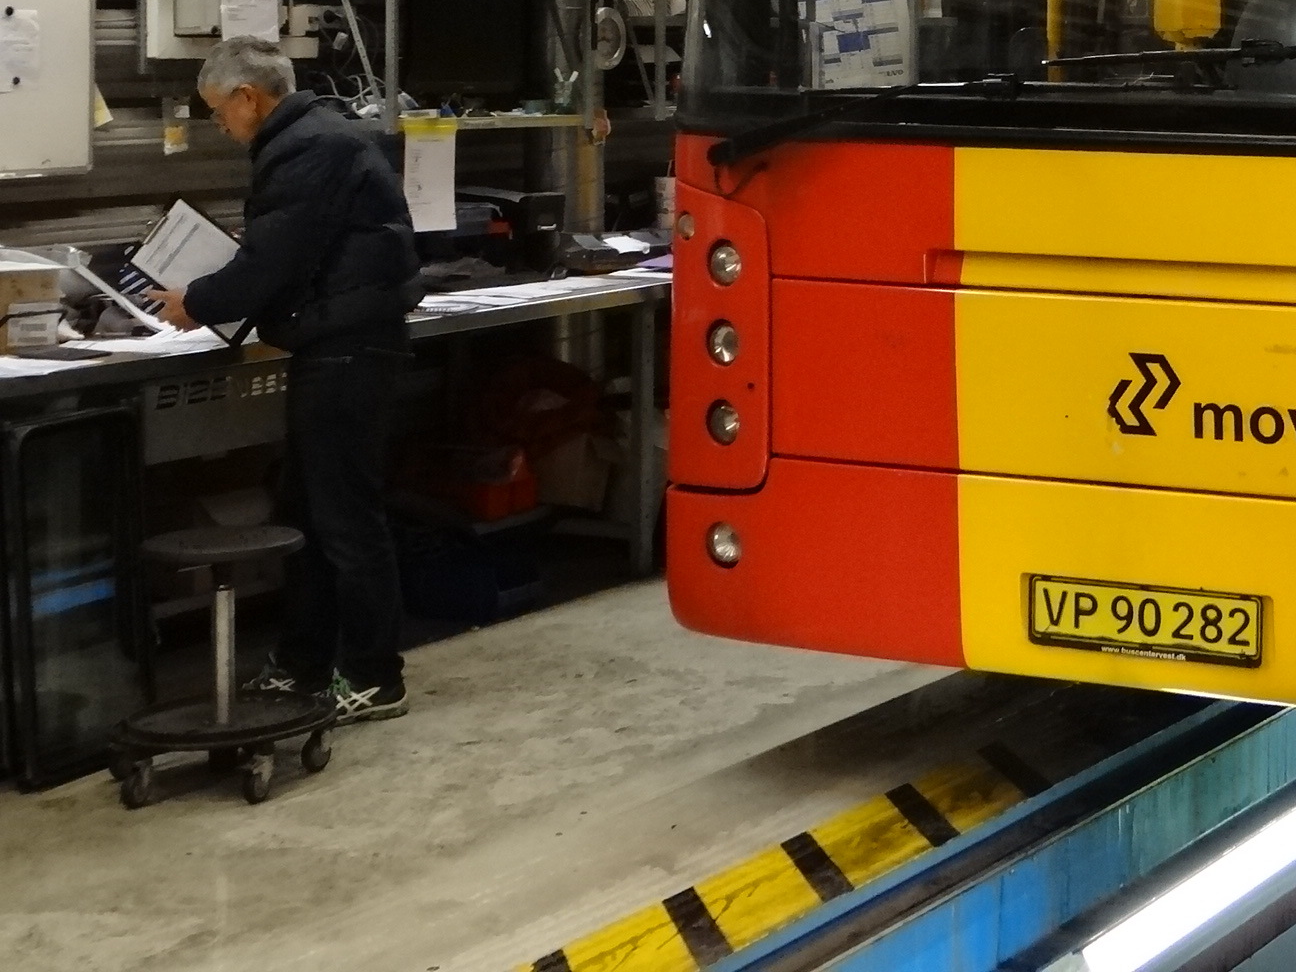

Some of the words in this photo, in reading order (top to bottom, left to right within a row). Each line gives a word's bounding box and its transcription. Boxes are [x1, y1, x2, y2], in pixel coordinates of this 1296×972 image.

[1042, 587, 1098, 629] VP
[1110, 595, 1162, 638] 90
[1170, 601, 1251, 647] 282
